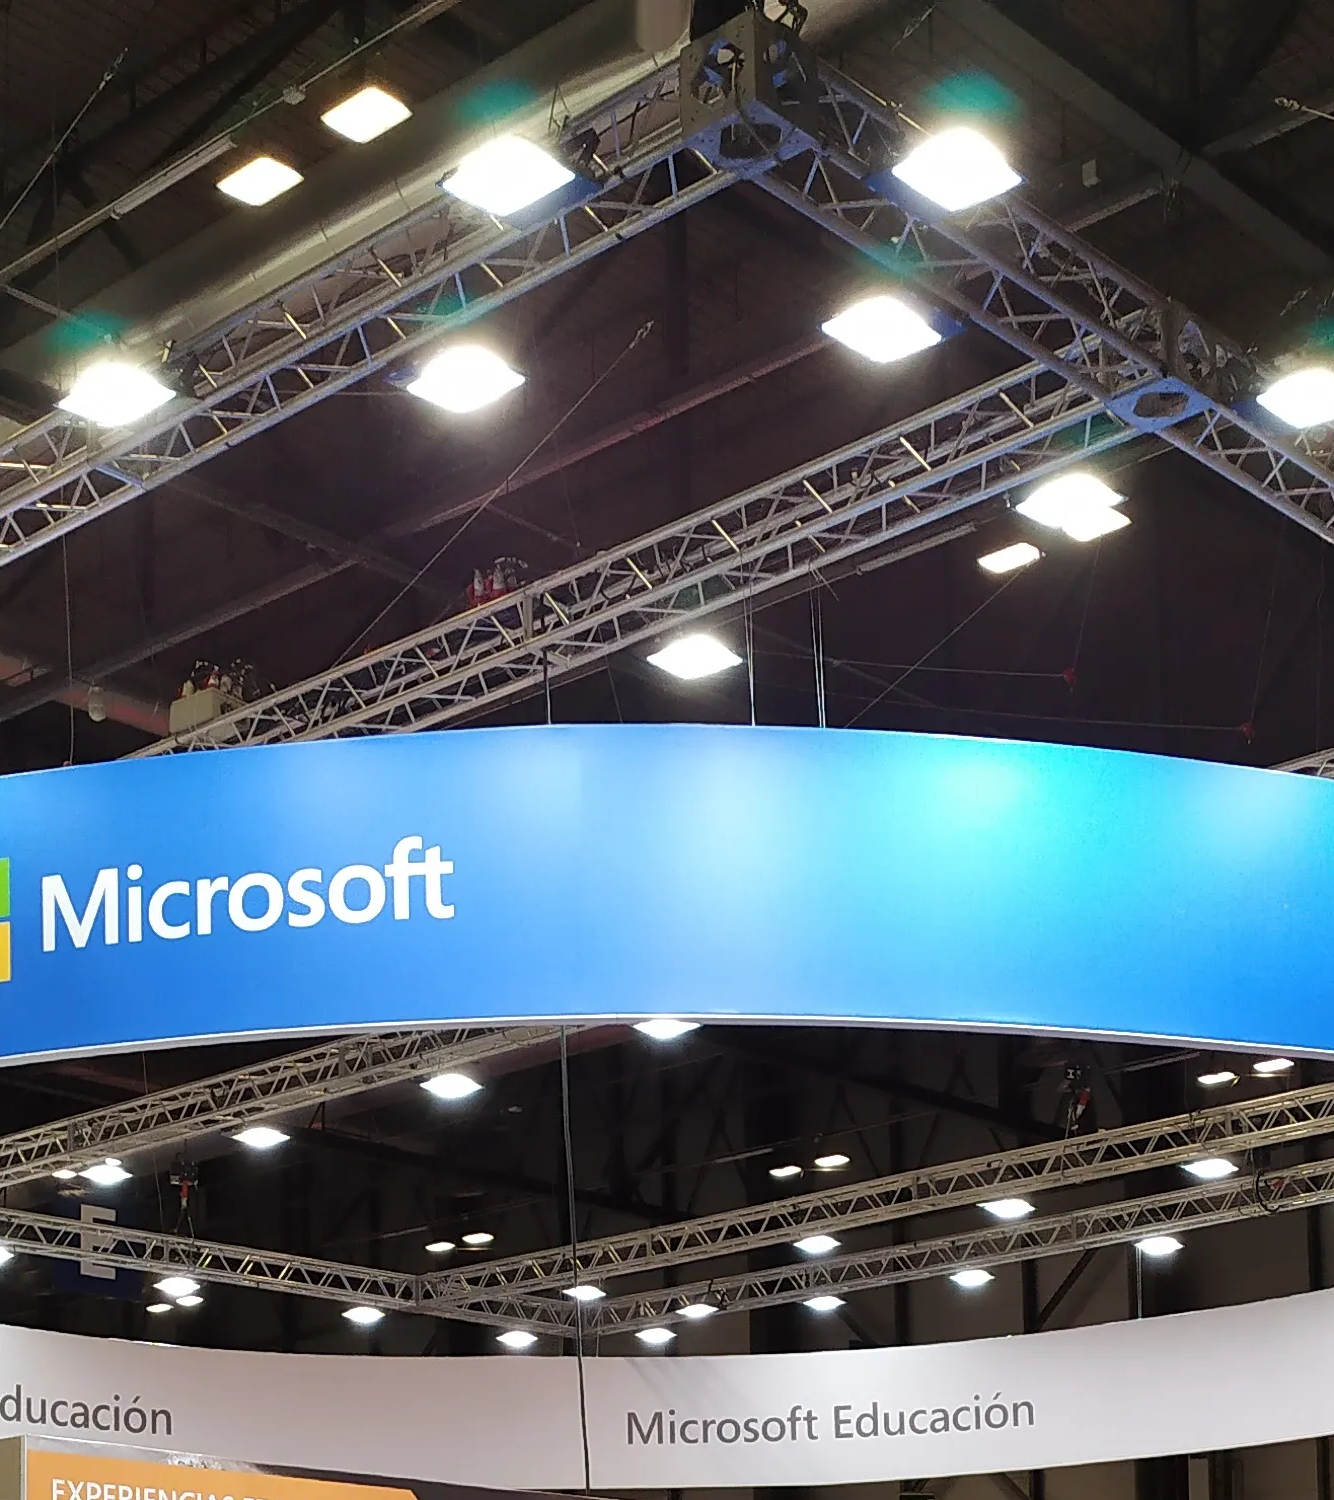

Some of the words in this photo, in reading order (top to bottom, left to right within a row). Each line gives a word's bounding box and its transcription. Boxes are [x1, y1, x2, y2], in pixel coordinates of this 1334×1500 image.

[40, 835, 455, 953] Microsoft
[626, 1405, 818, 1445] Microsoft
[834, 1391, 1035, 1439] Educación
